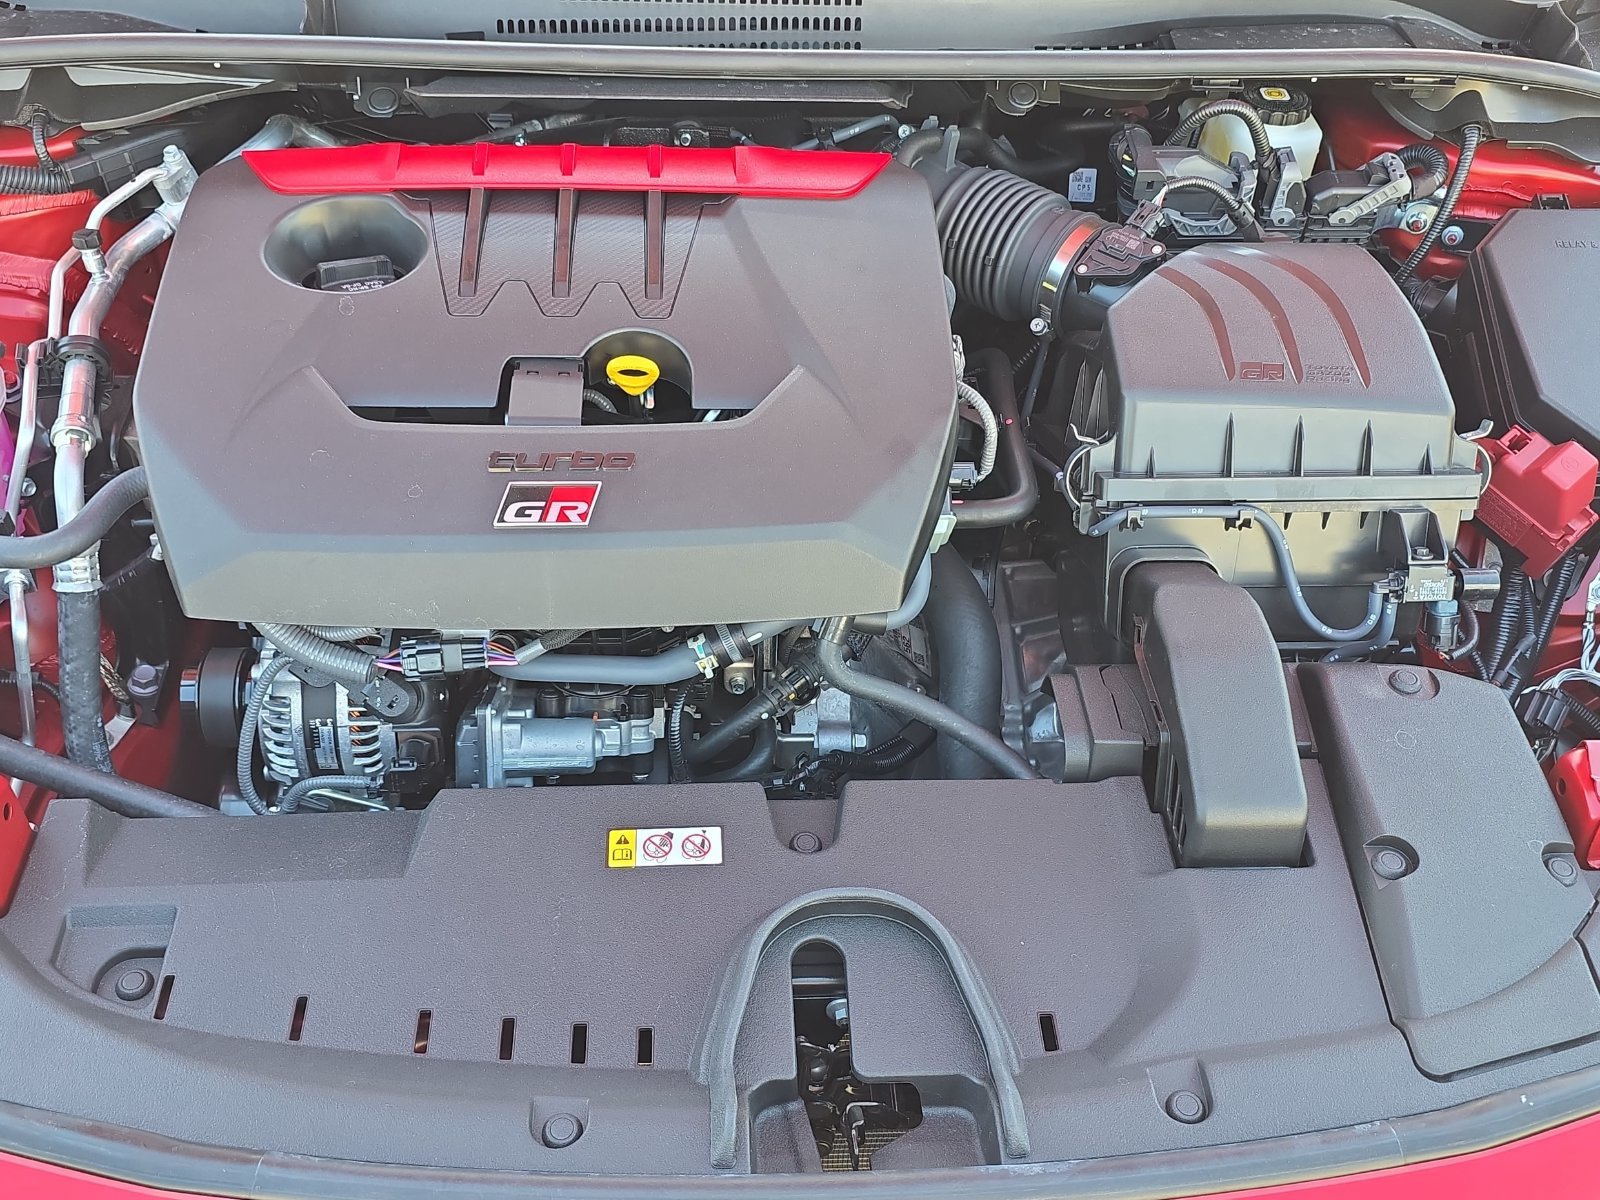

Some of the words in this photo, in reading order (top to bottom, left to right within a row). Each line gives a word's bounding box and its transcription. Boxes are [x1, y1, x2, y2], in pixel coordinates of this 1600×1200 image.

[1554, 240, 1587, 248] RELAY
[1241, 366, 1284, 381] GR
[488, 451, 636, 472] turbo
[503, 501, 589, 523] GR
